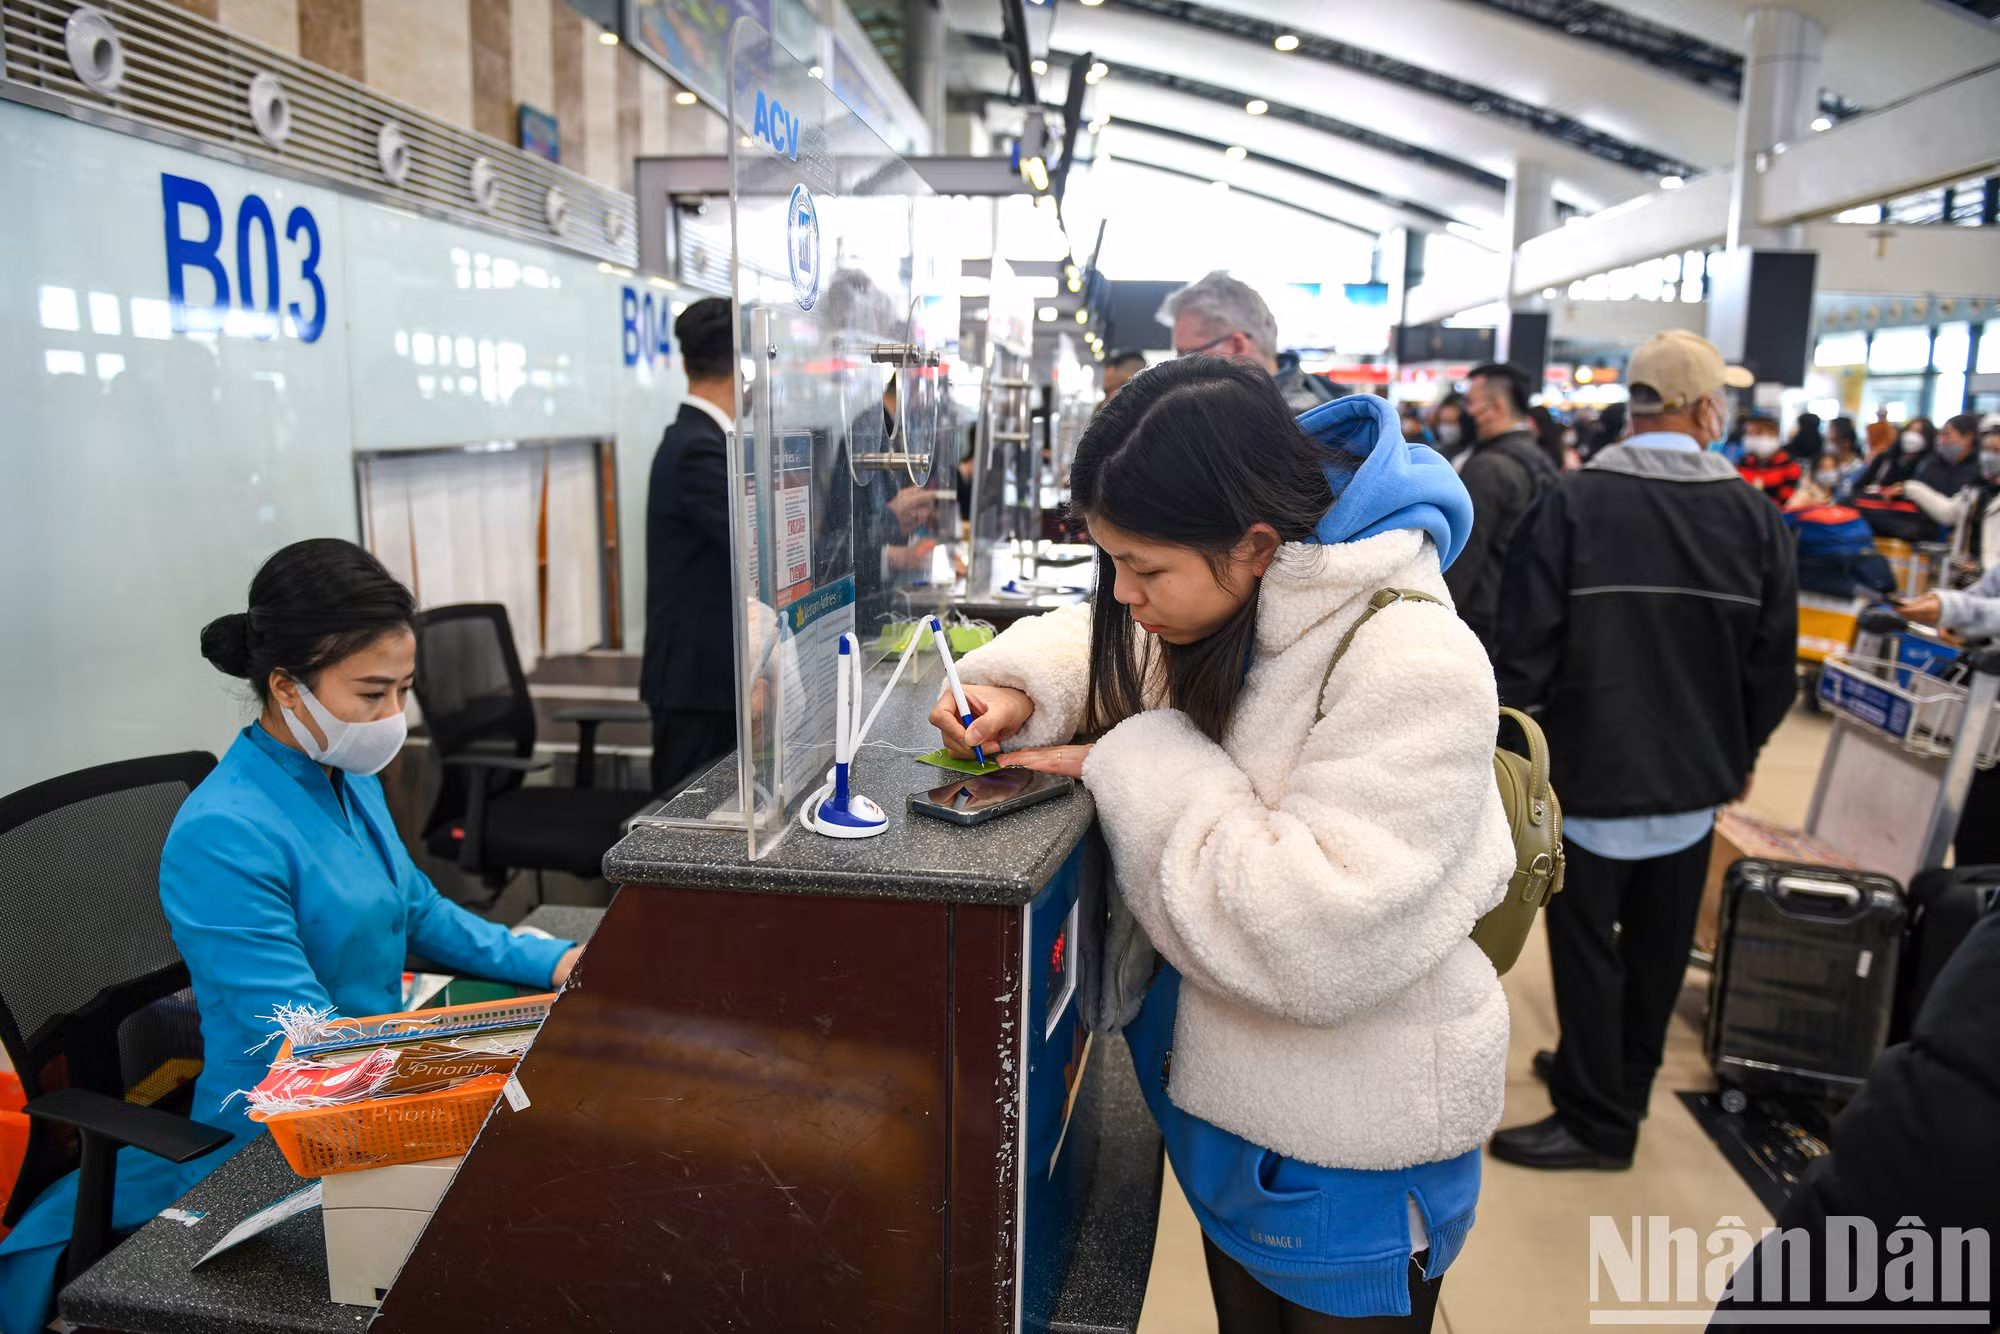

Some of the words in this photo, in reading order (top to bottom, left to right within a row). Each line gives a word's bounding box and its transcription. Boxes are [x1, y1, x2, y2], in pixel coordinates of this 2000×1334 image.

[753, 89, 799, 161] ACV
[161, 173, 327, 344] B03
[622, 286, 671, 368] B04
[411, 1063, 497, 1077] Priority
